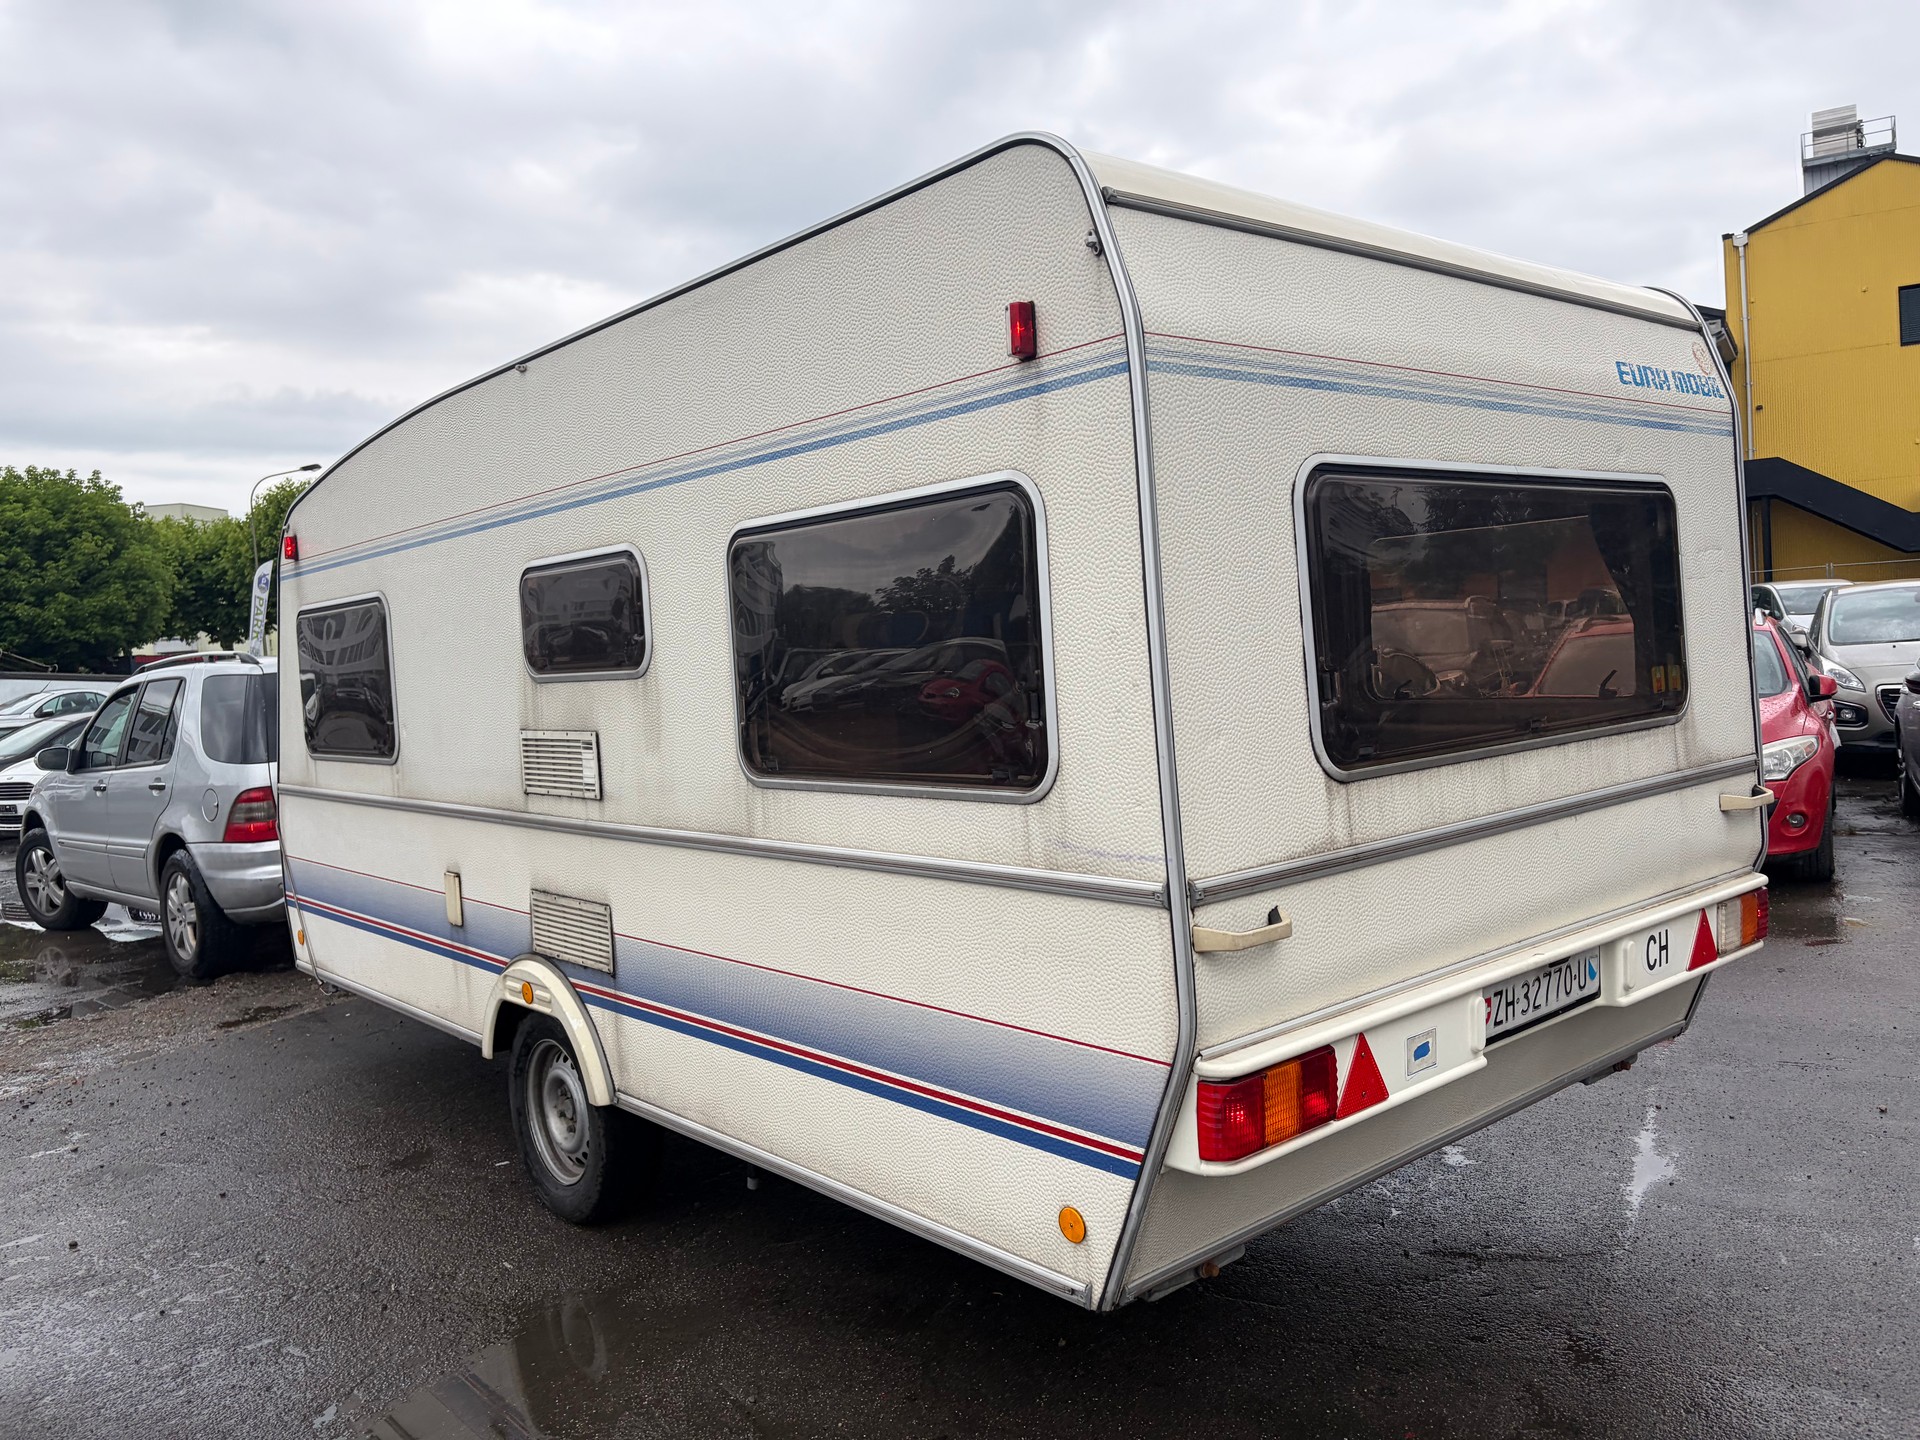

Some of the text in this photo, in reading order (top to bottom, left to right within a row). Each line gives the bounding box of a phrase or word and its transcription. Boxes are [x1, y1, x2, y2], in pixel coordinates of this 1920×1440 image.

[1615, 361, 1725, 398] EURA MOBIL
[1646, 929, 1669, 971] CH
